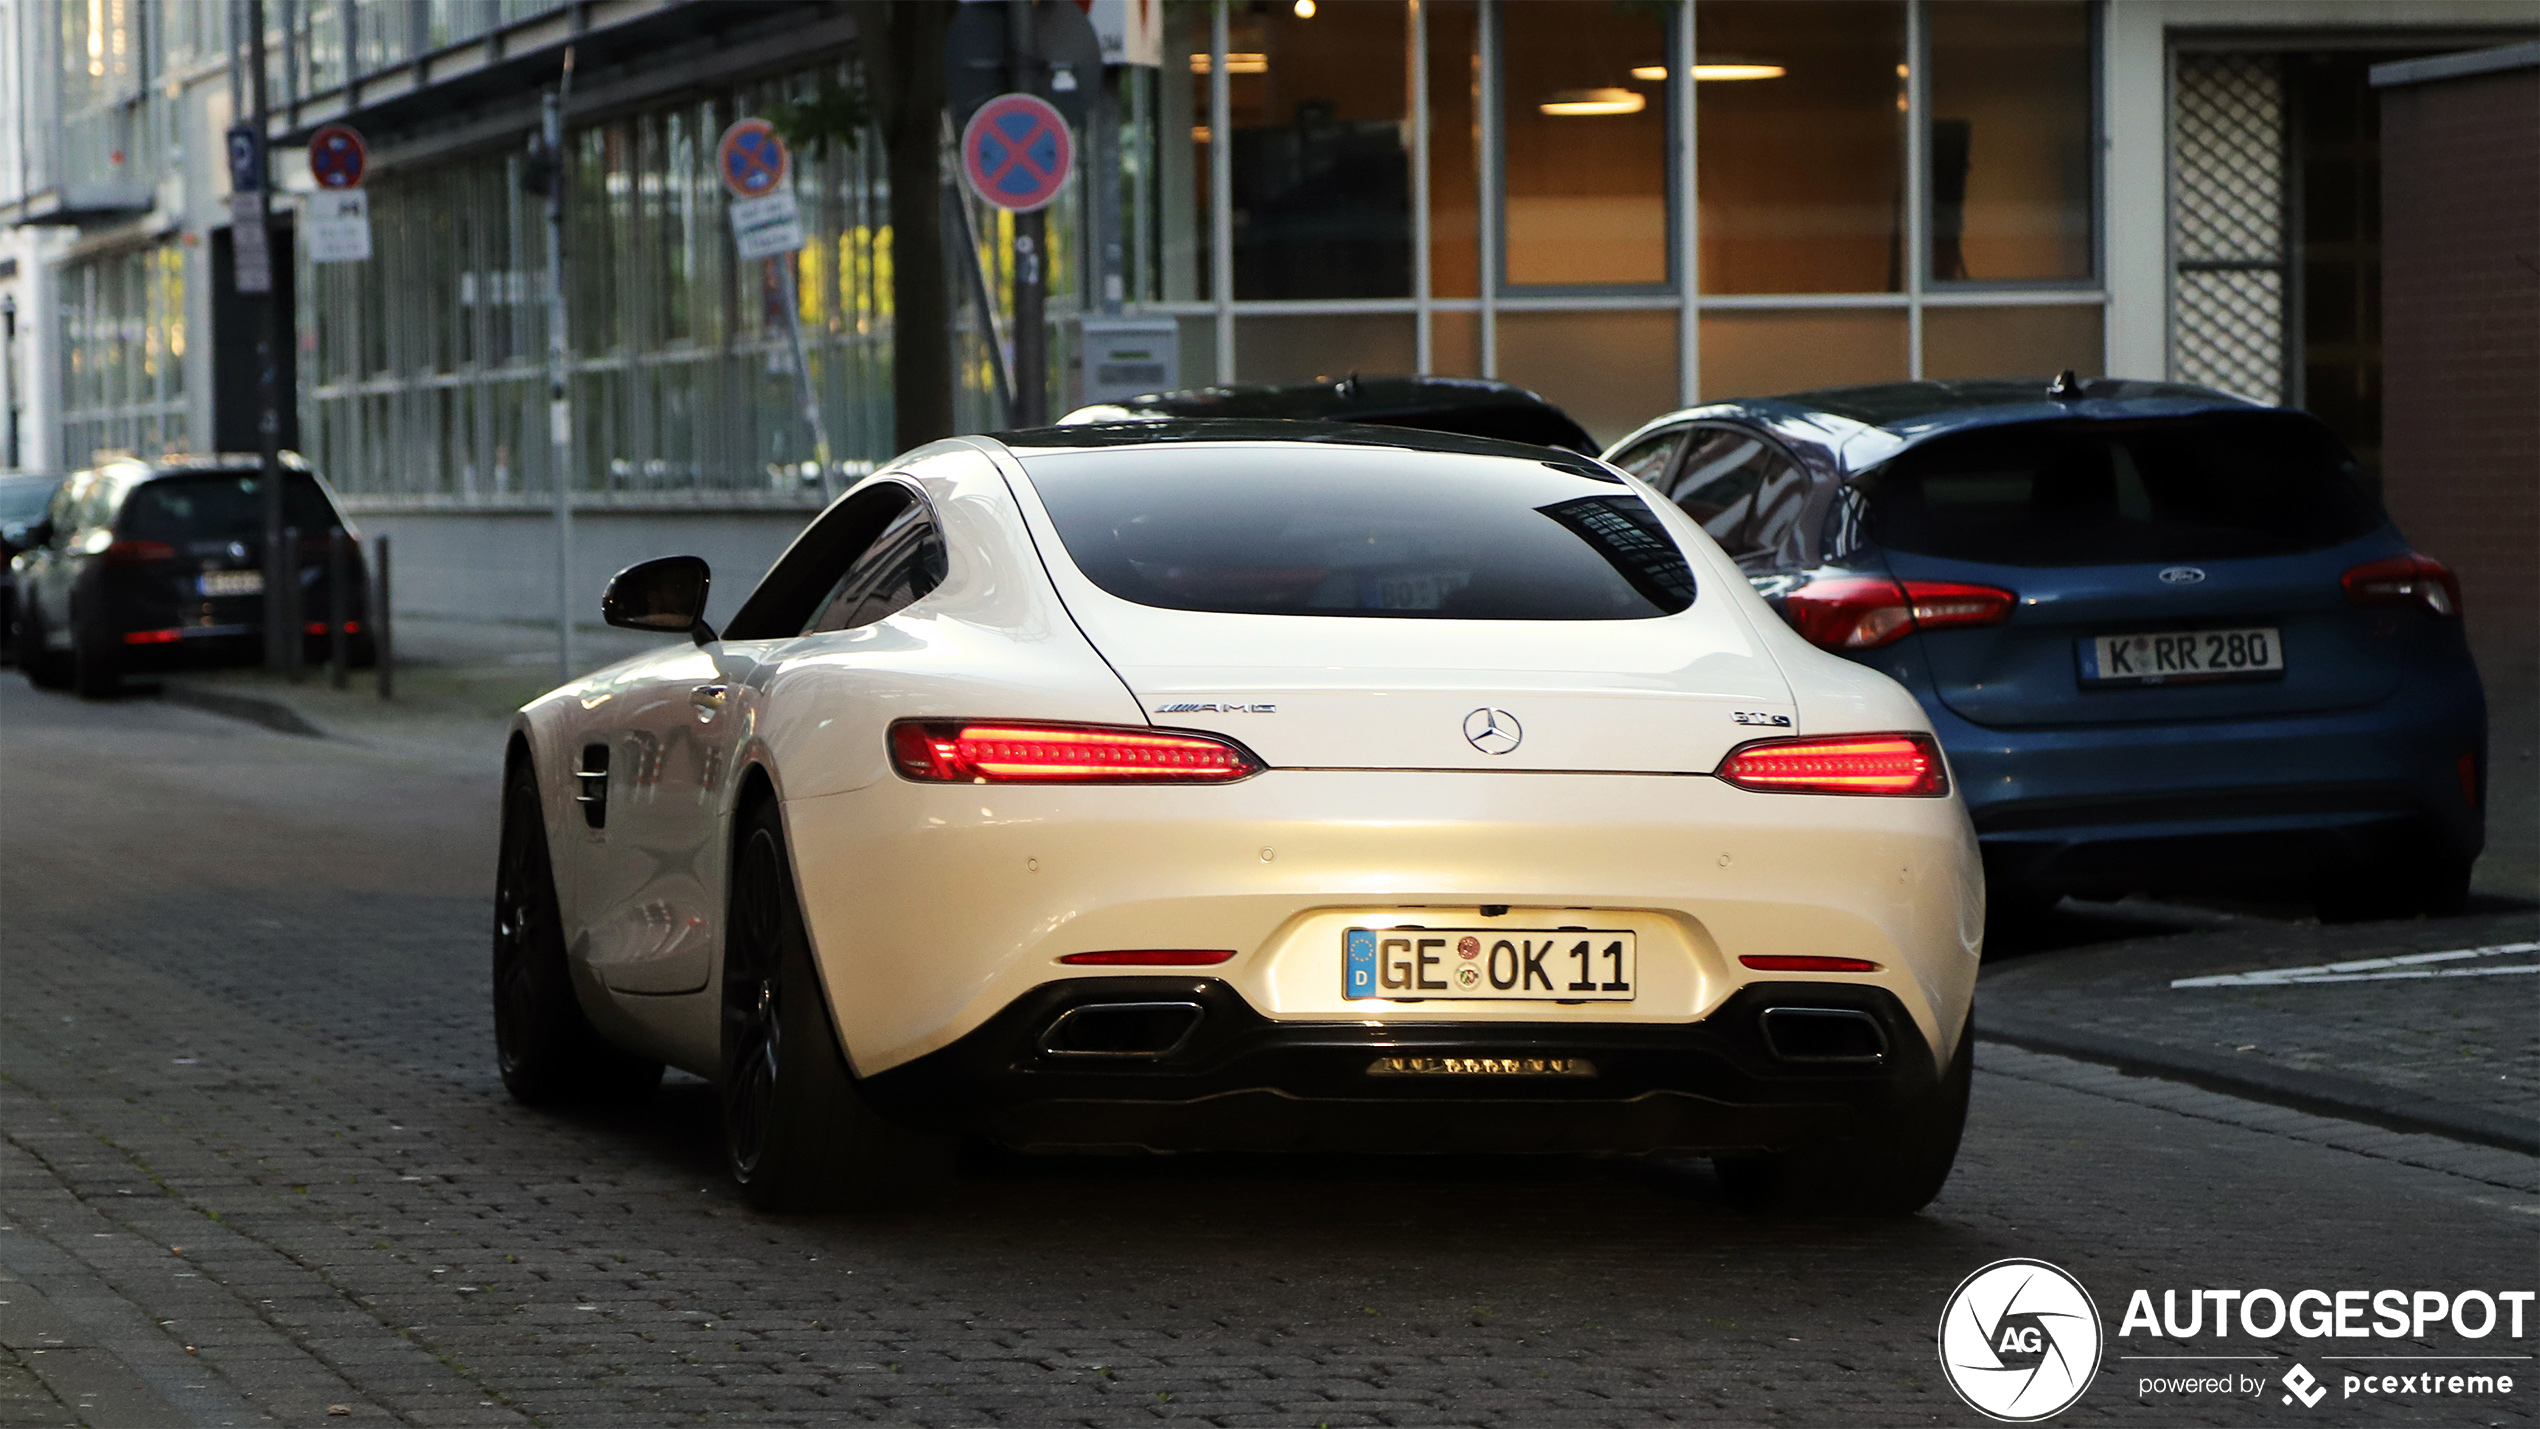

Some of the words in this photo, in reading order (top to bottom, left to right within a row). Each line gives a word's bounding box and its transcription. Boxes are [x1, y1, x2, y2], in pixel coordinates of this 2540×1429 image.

[2109, 640, 2133, 674] K
[2154, 637, 2200, 671] RR
[2206, 633, 2269, 668] 280
[1354, 971, 1368, 986] D
[1379, 938, 1448, 991] GE
[1487, 939, 1554, 991] OK
[1568, 940, 1630, 992] 11
